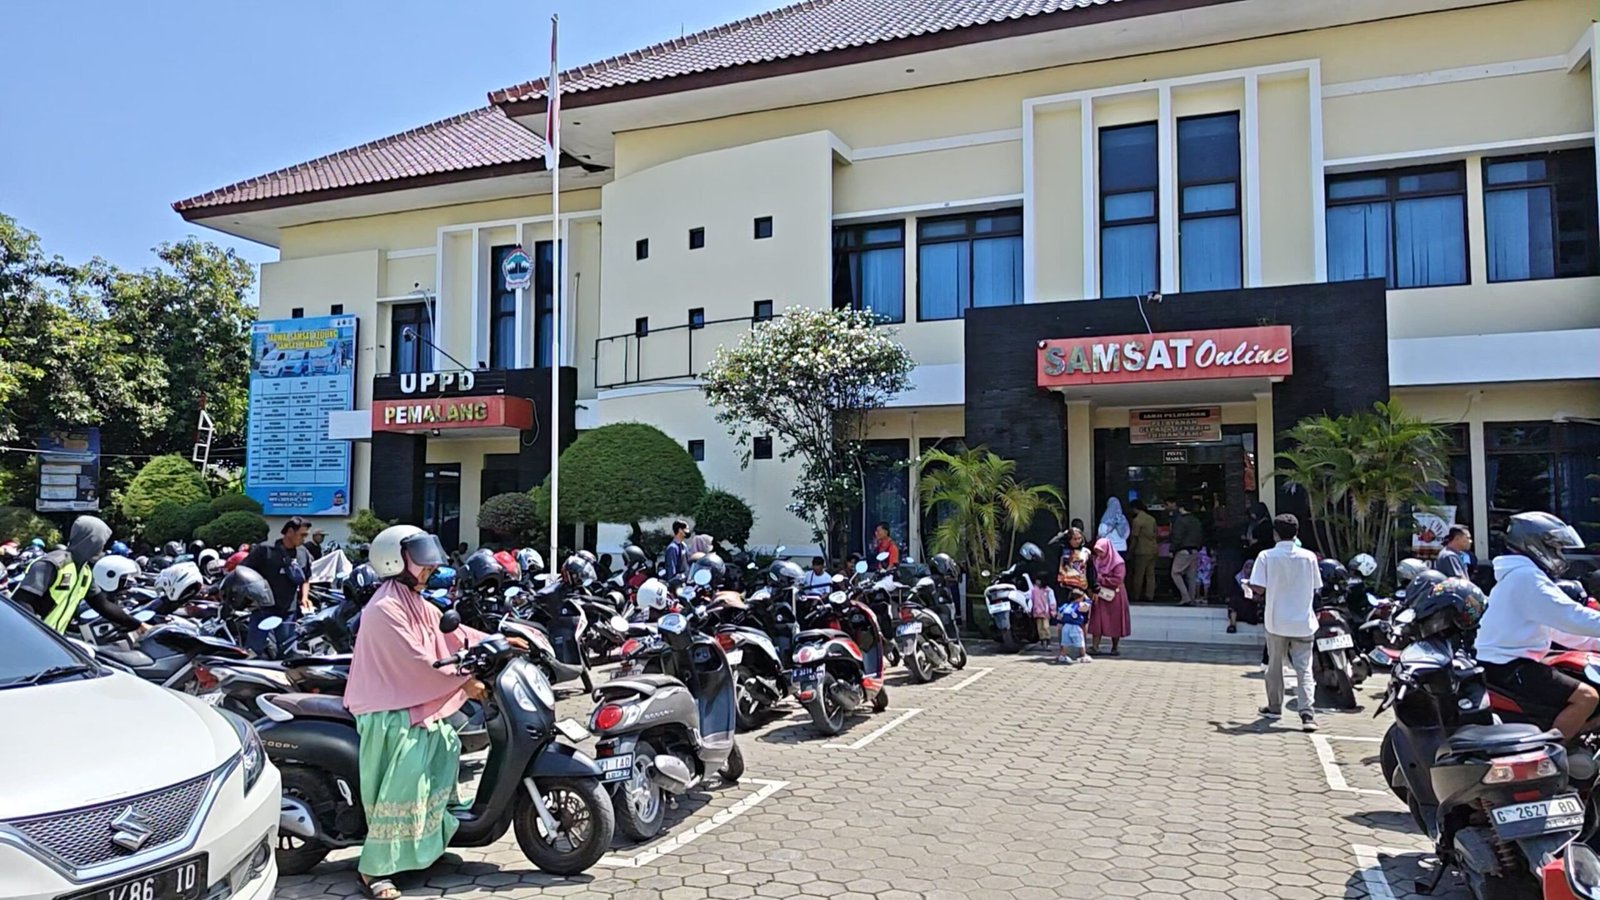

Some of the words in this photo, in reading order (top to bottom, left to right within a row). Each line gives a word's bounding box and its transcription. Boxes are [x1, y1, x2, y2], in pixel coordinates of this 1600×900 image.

[1044, 339, 1193, 376] SAMSAT
[1195, 339, 1289, 368] Online
[400, 372, 474, 394] UPPD
[384, 402, 488, 424] PEMALANG
[1496, 810, 1506, 822] G
[1516, 803, 1549, 819] 2627
[177, 863, 196, 893] ID
